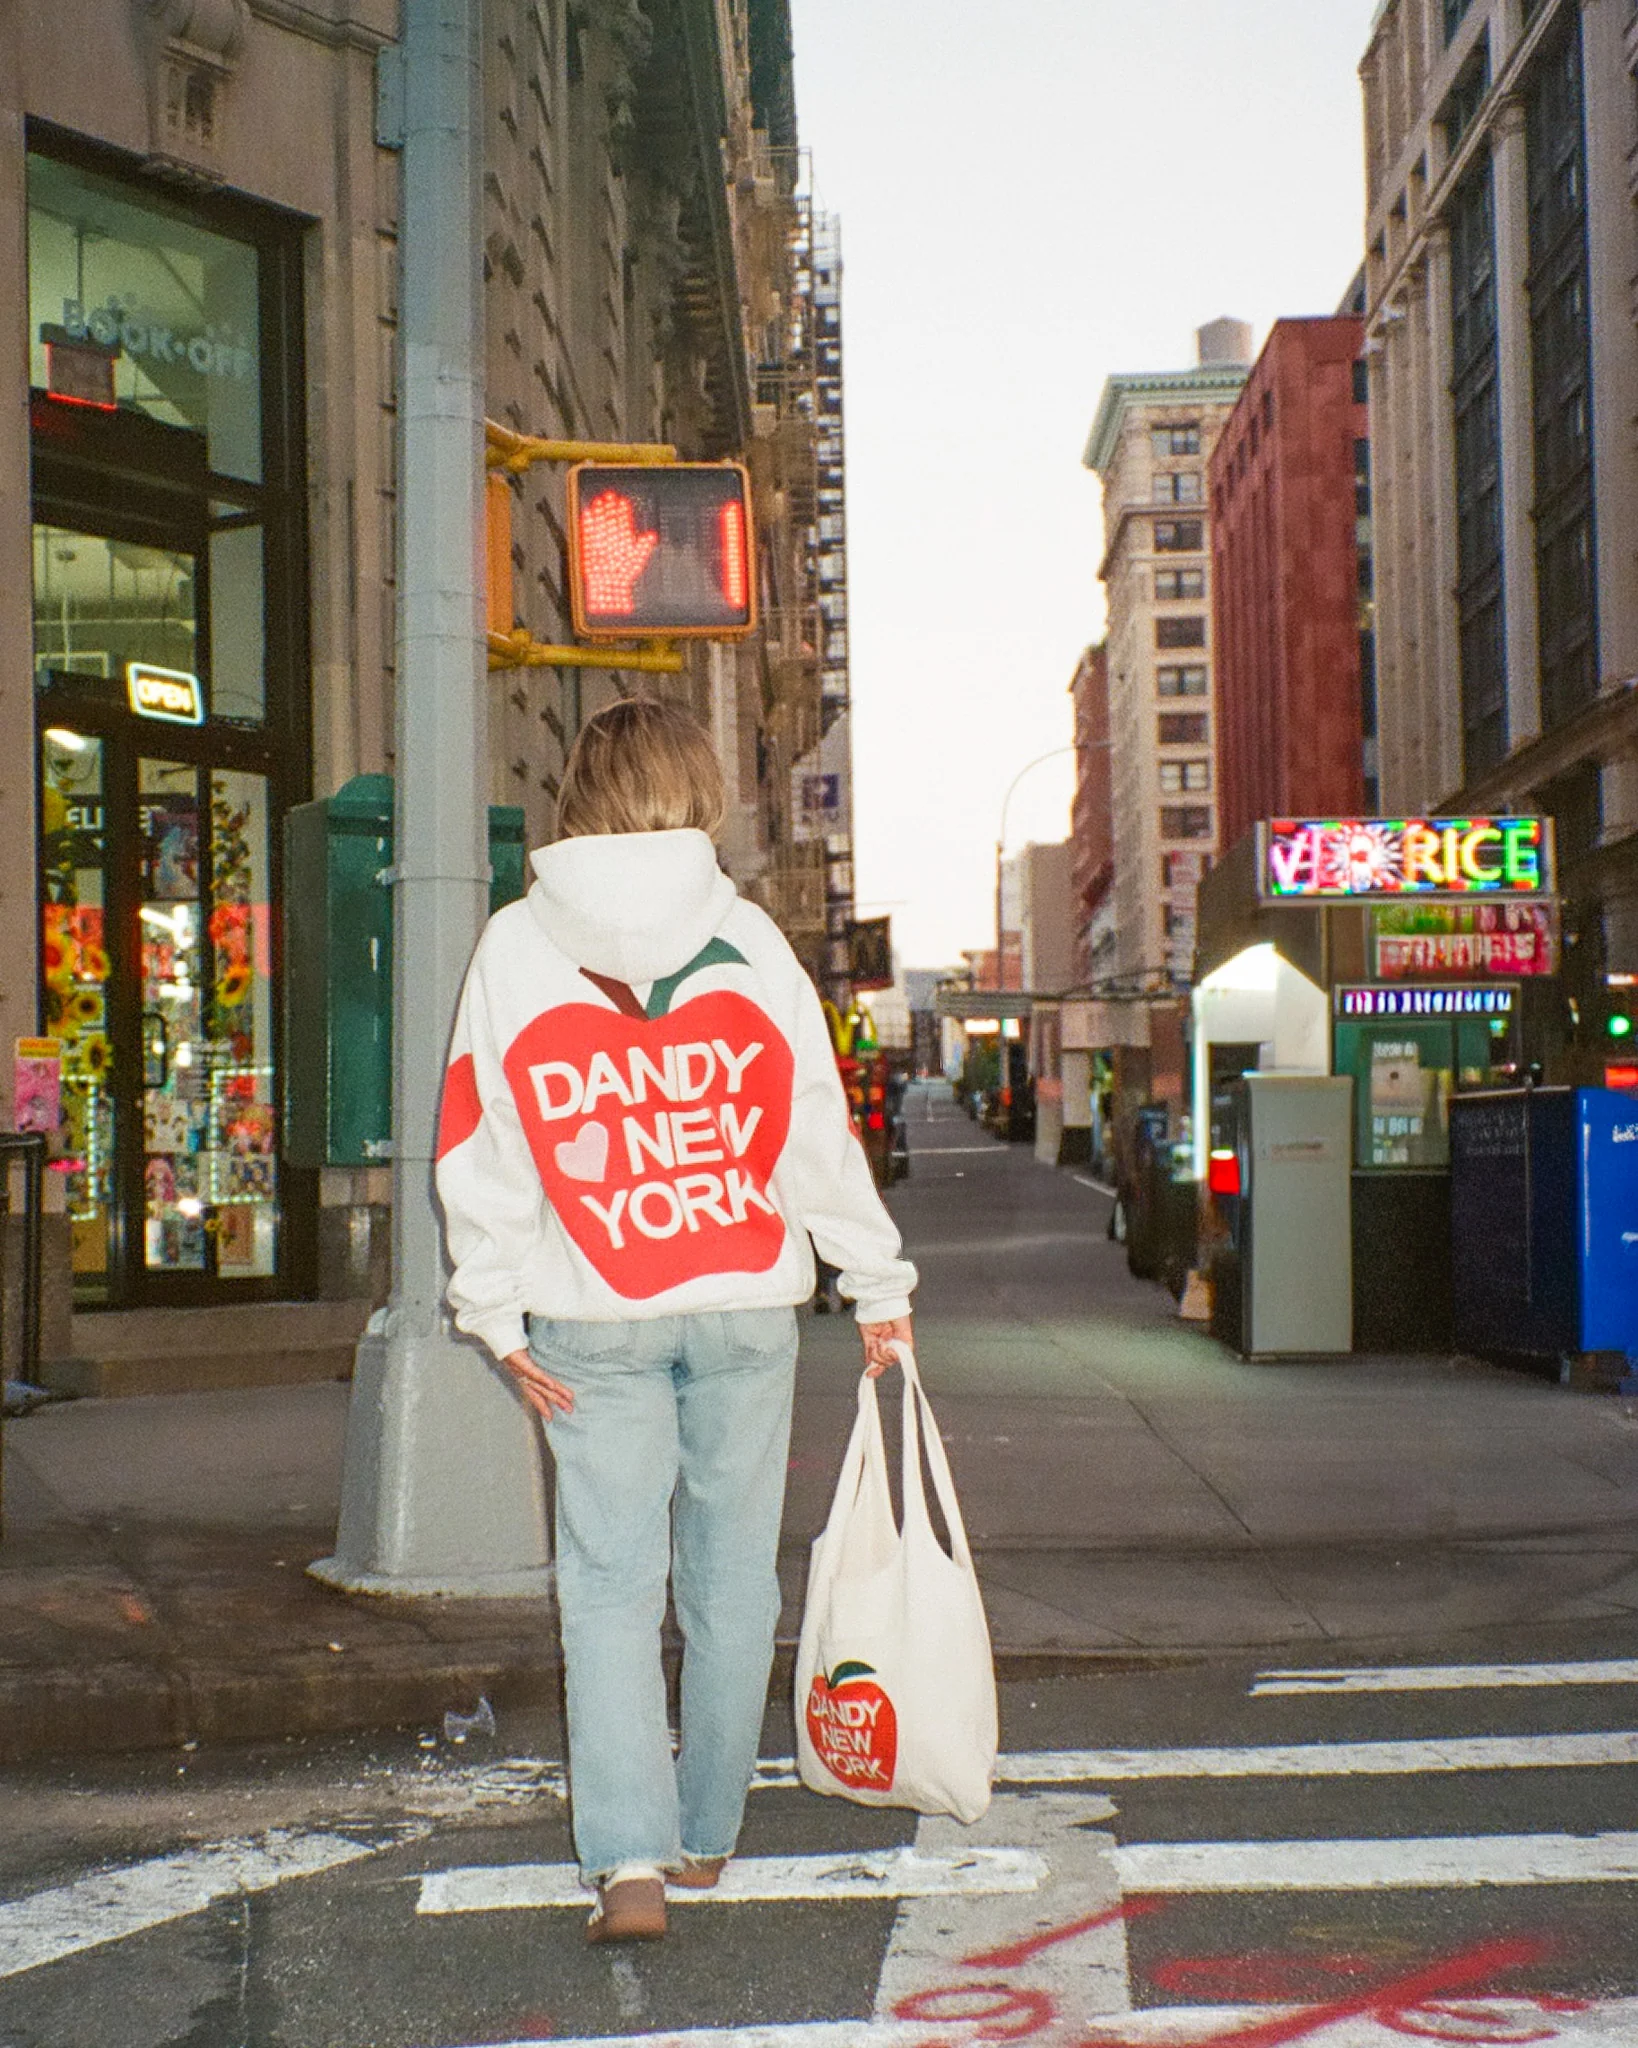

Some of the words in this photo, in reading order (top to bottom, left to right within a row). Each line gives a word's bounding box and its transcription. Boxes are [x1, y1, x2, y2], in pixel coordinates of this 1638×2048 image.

[136, 678, 191, 711] OPEN
[528, 1039, 764, 1121] DANDY
[622, 1103, 764, 1175] NEW
[579, 1168, 777, 1249] YORK
[811, 1690, 883, 1728] DANDY
[820, 1722, 872, 1755] NEW
[818, 1748, 889, 1782] YORK
